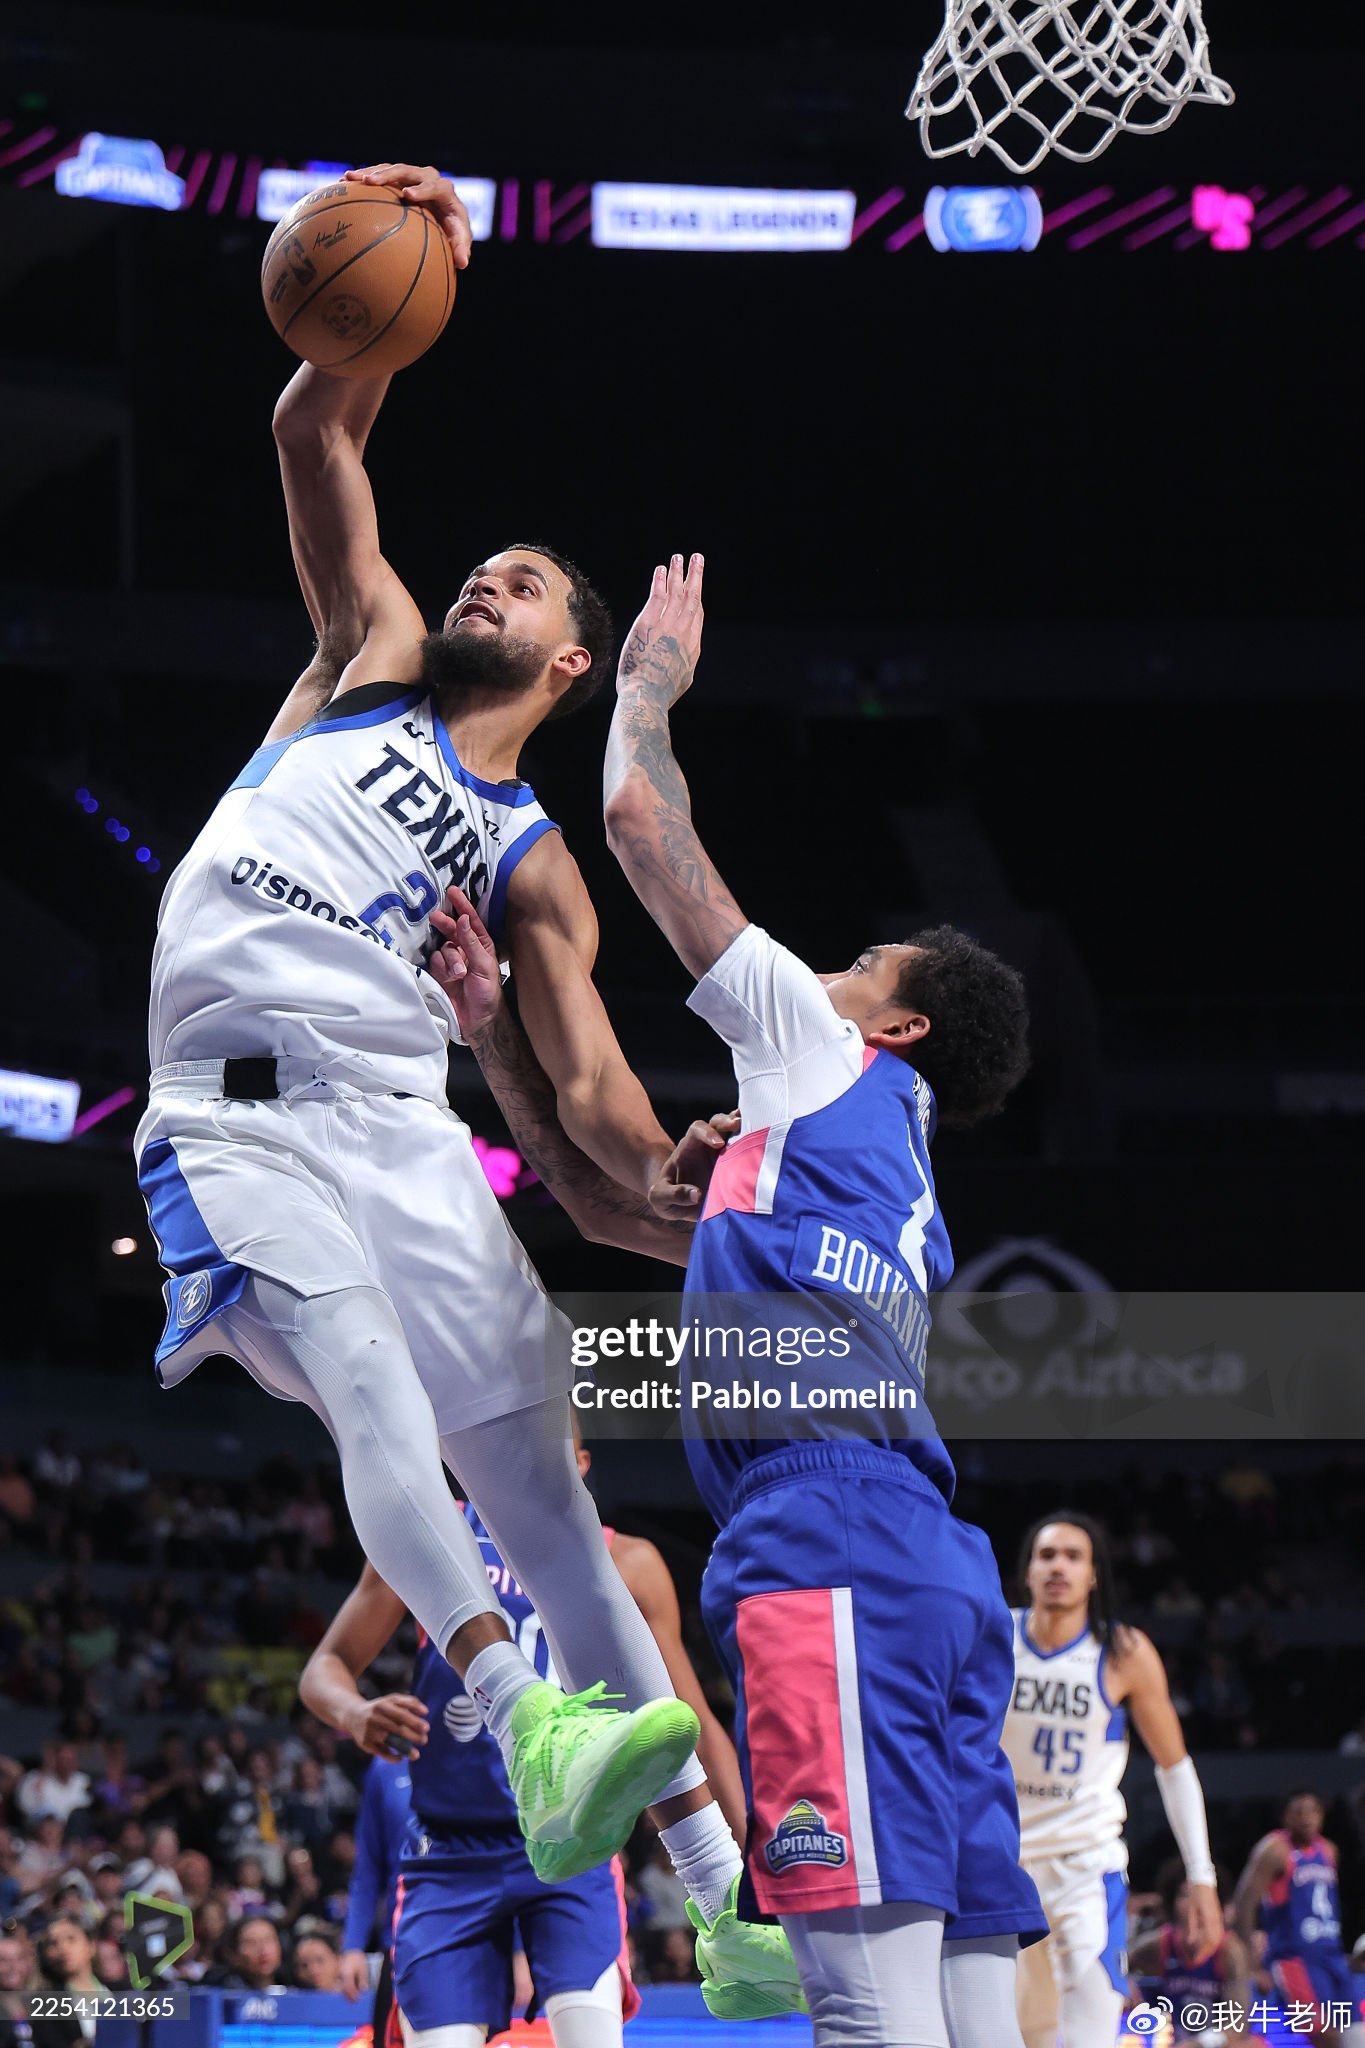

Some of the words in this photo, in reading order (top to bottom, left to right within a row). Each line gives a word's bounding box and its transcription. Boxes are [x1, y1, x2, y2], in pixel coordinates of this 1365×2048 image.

[355, 741, 490, 902] TEXAS
[1014, 1677, 1092, 1719] EXAS
[1033, 1726, 1086, 1776] 45
[767, 1834, 842, 1861] CAPITANES
